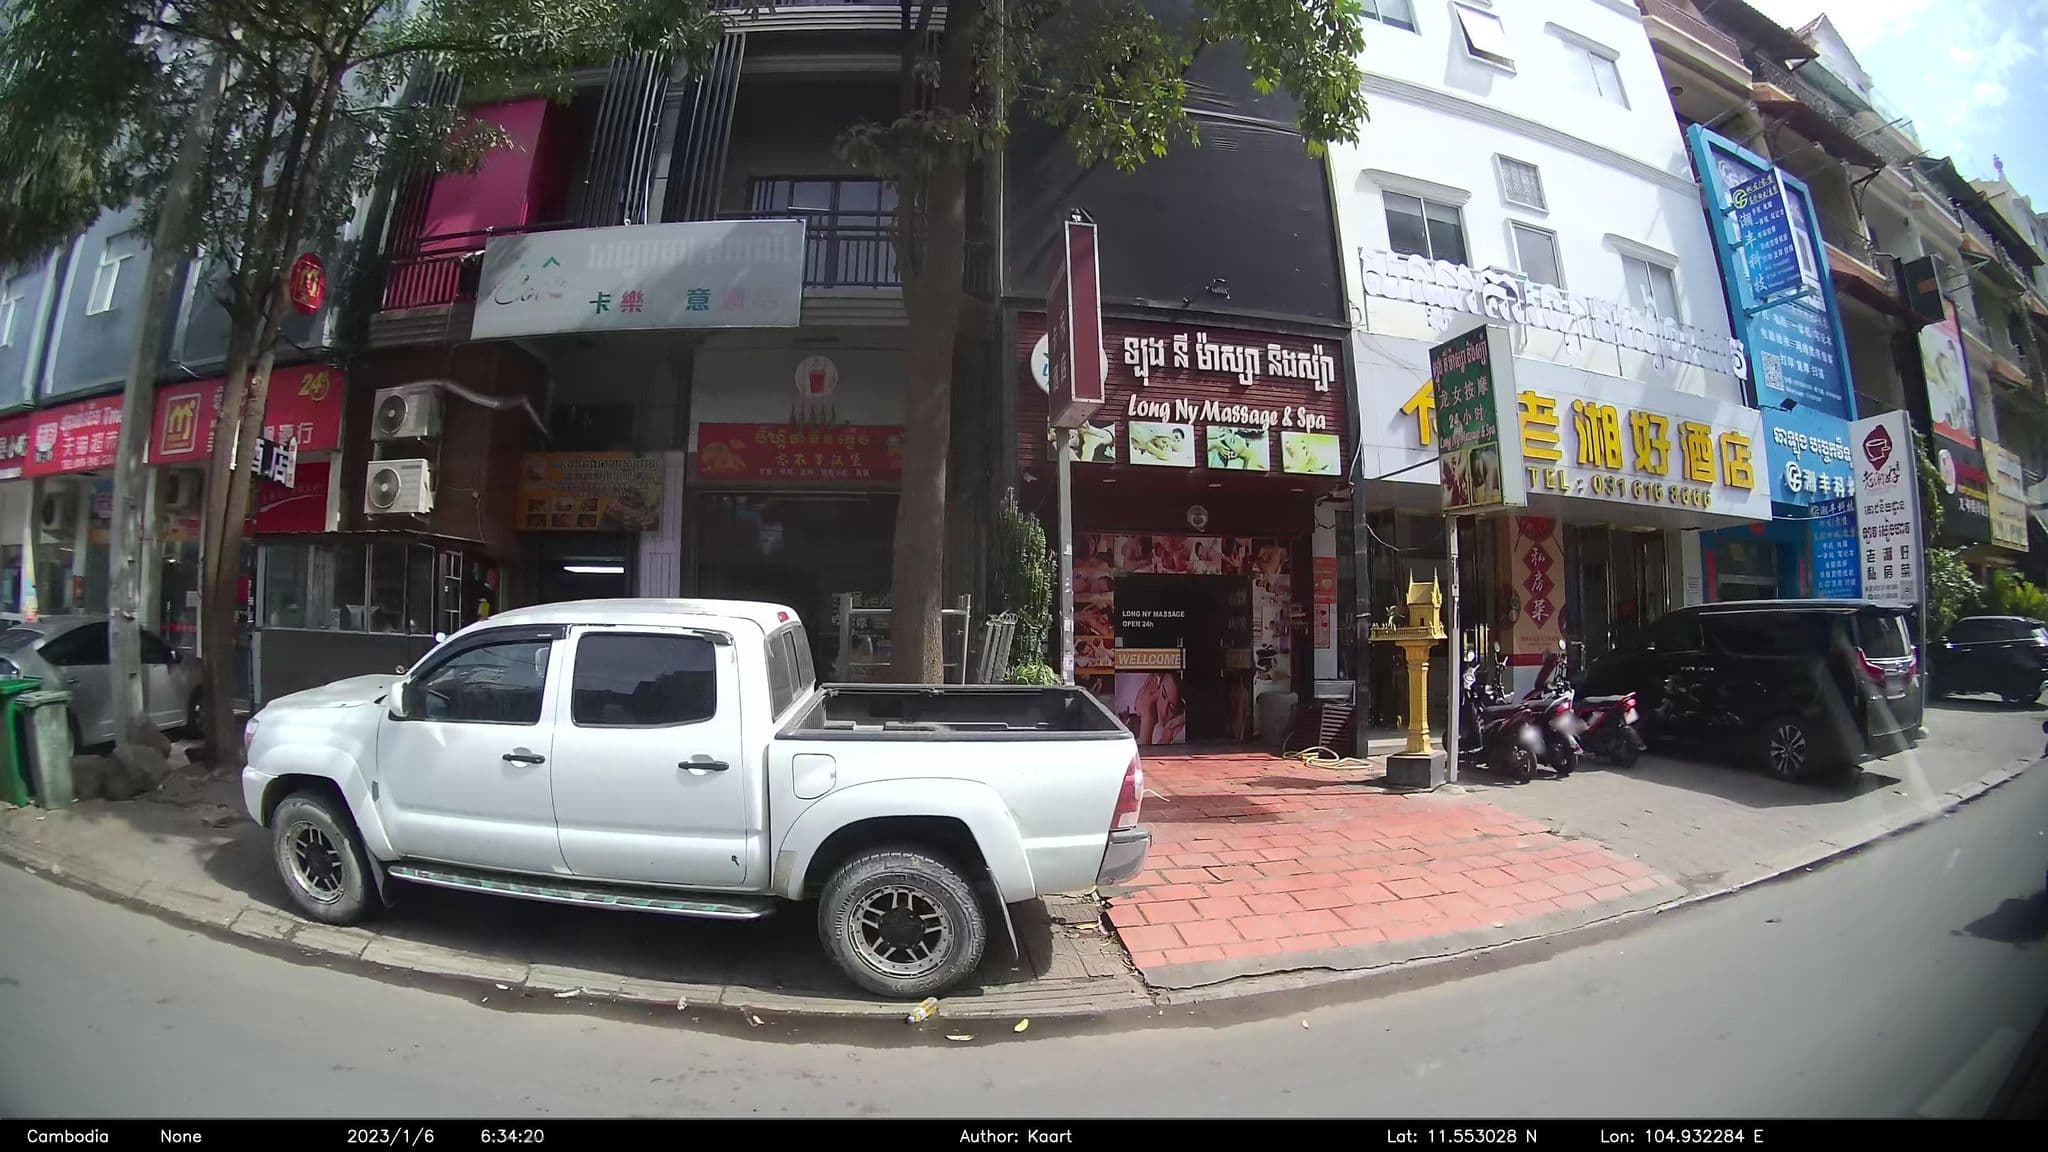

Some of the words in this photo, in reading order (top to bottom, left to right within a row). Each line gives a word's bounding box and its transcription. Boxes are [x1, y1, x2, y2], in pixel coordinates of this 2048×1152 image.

[1128, 394, 1170, 424] Long
[1175, 397, 1199, 426] Ny
[1200, 400, 1279, 431] Massage
[1281, 406, 1294, 427] &
[1296, 407, 1327, 434] Spa
[1527, 466, 1570, 491] TEL
[1531, 547, 1549, 621] 私房菜
[1122, 610, 1141, 618] LONG
[1142, 610, 1152, 618] NY
[1153, 610, 1185, 618] MASSAGE
[1122, 620, 1141, 628] OPEN
[1118, 653, 1182, 666] WELLCOME
